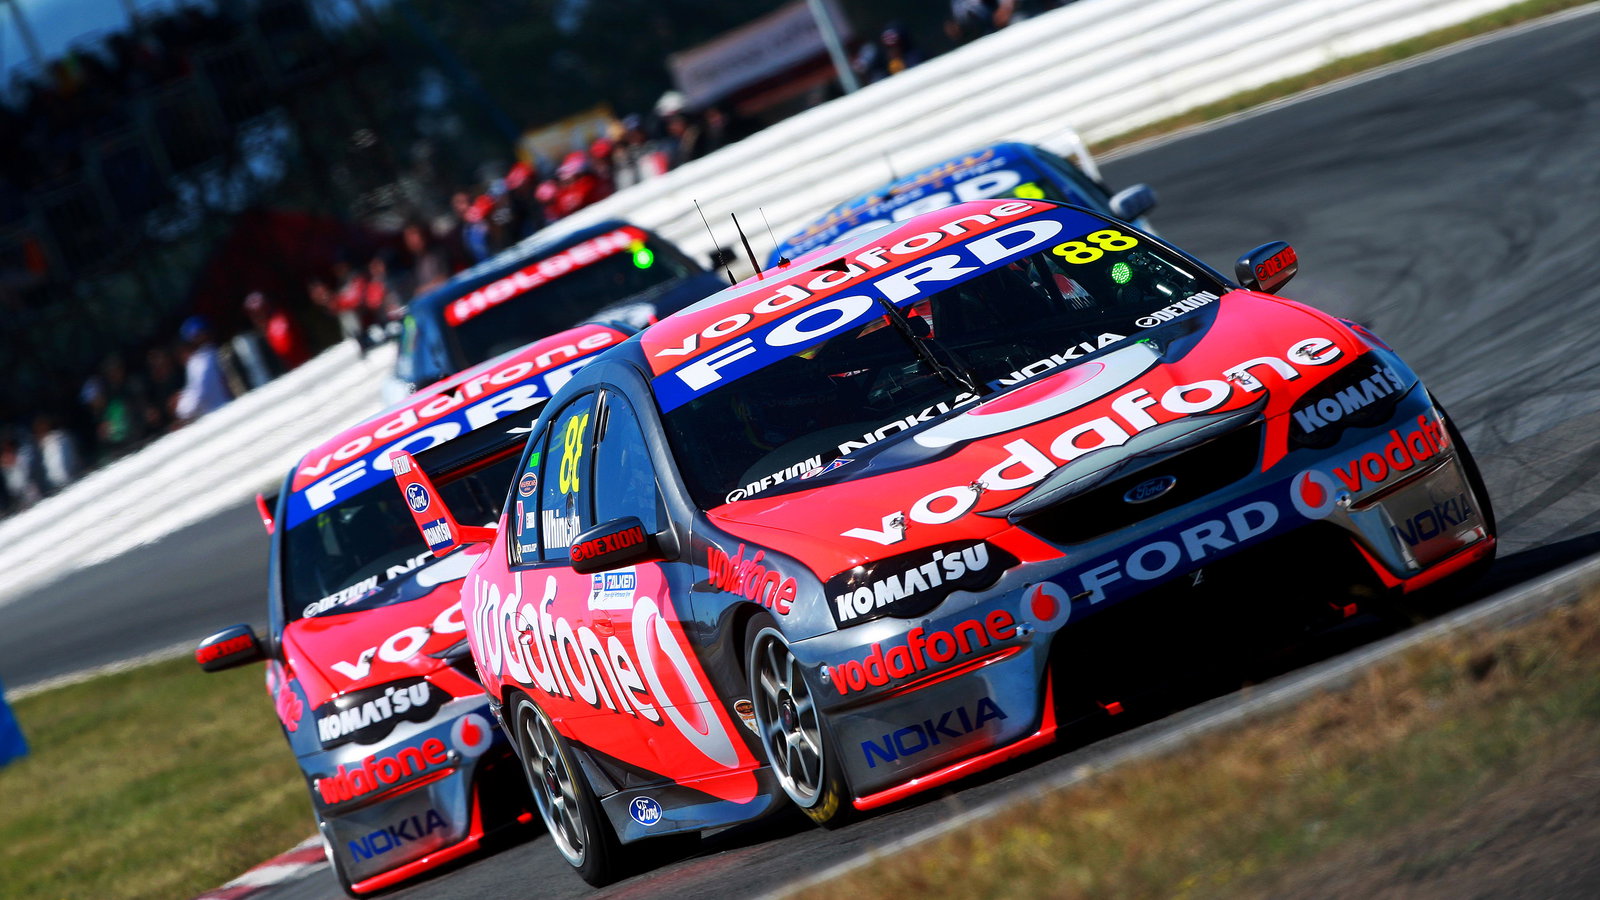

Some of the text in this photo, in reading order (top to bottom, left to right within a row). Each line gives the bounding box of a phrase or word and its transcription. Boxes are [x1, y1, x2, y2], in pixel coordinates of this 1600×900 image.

[655, 200, 1034, 357] vodafone
[1052, 230, 1139, 265] 88
[675, 219, 1063, 391] FORD
[1159, 291, 1220, 322] DEXION
[998, 332, 1126, 387] NOKIA
[300, 331, 613, 477] vodafone
[837, 390, 981, 456] NOKIA
[840, 336, 1344, 546] vodafone
[408, 486, 427, 510] Ford
[1390, 493, 1476, 548] NOKIA
[584, 526, 645, 562] DEXION
[1079, 500, 1280, 605] FORD
[707, 542, 798, 615] vodafone
[836, 542, 990, 622] KOMATSU
[471, 568, 662, 723] vodafone
[828, 608, 1017, 695] vodafone
[317, 681, 431, 742] KOMATSU
[860, 696, 1008, 769] NOKIA
[318, 737, 448, 805] vodafone
[346, 808, 448, 864] NOKIA
[634, 800, 662, 821] Ford
